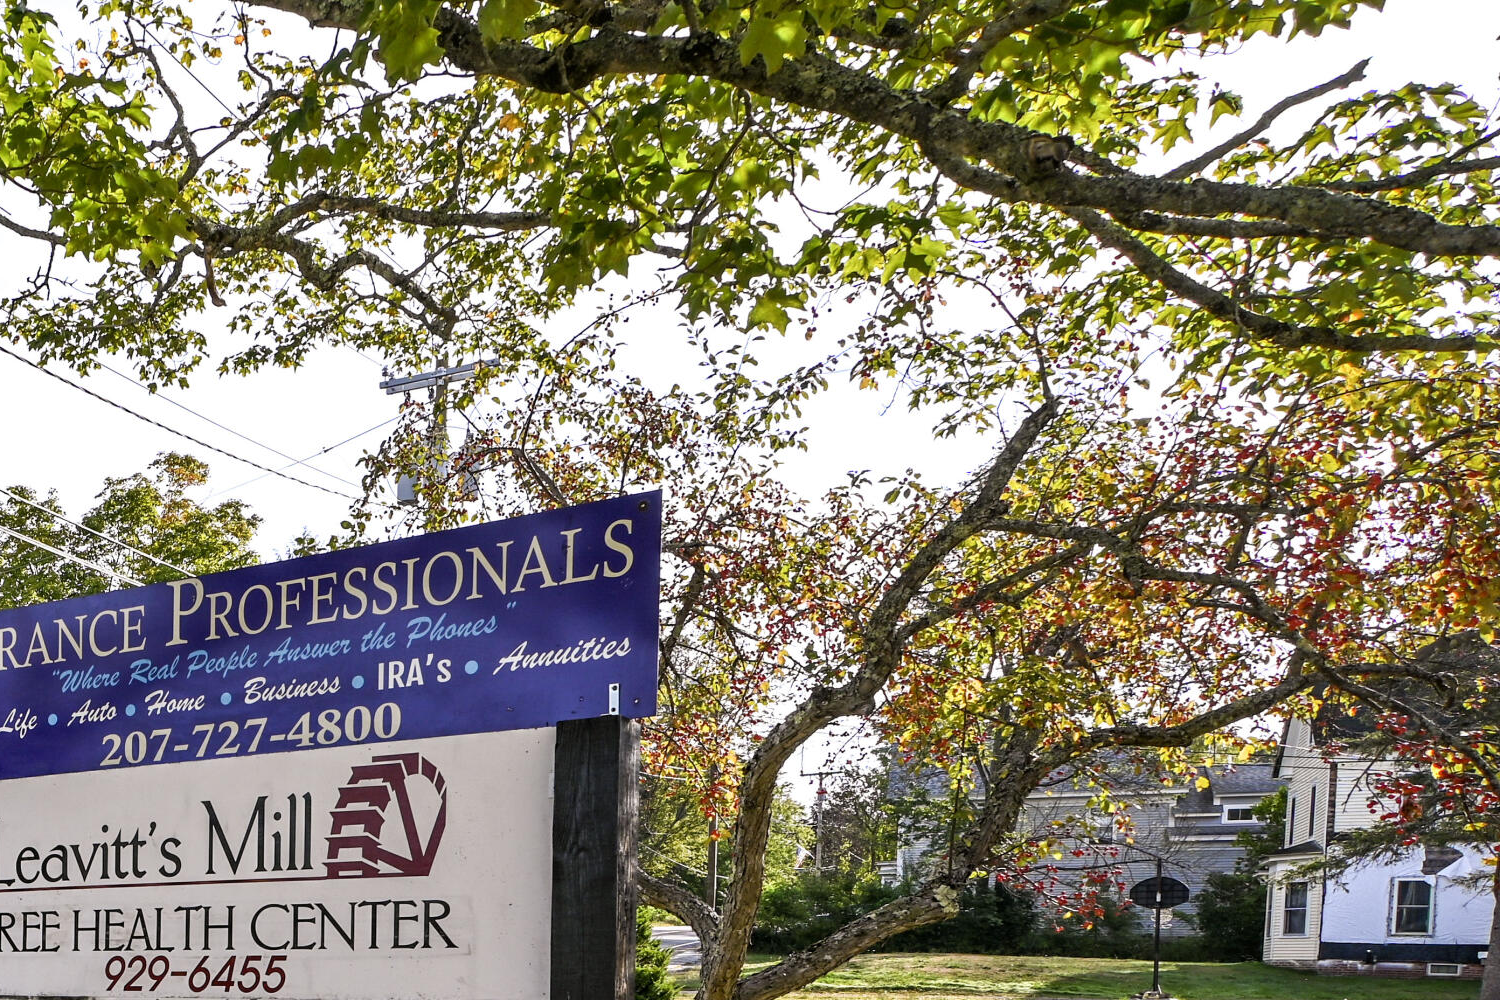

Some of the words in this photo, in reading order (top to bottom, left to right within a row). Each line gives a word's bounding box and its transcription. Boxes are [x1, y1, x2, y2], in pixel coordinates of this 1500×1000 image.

[165, 519, 634, 647] PROFESSIONALS
[67, 699, 117, 727] Auto
[145, 690, 206, 717] Home
[243, 676, 341, 704] Business
[377, 653, 452, 691] IRA's
[492, 636, 632, 675] Annuities
[130, 656, 179, 684] Real
[186, 645, 257, 680] People
[263, 636, 352, 667] Answer
[361, 623, 397, 652] the
[100, 701, 402, 766] 207-727-4800
[200, 791, 314, 876] Mill
[72, 904, 236, 953] HEALTH
[250, 899, 459, 952] CENTER
[104, 954, 288, 993] 929-6455
